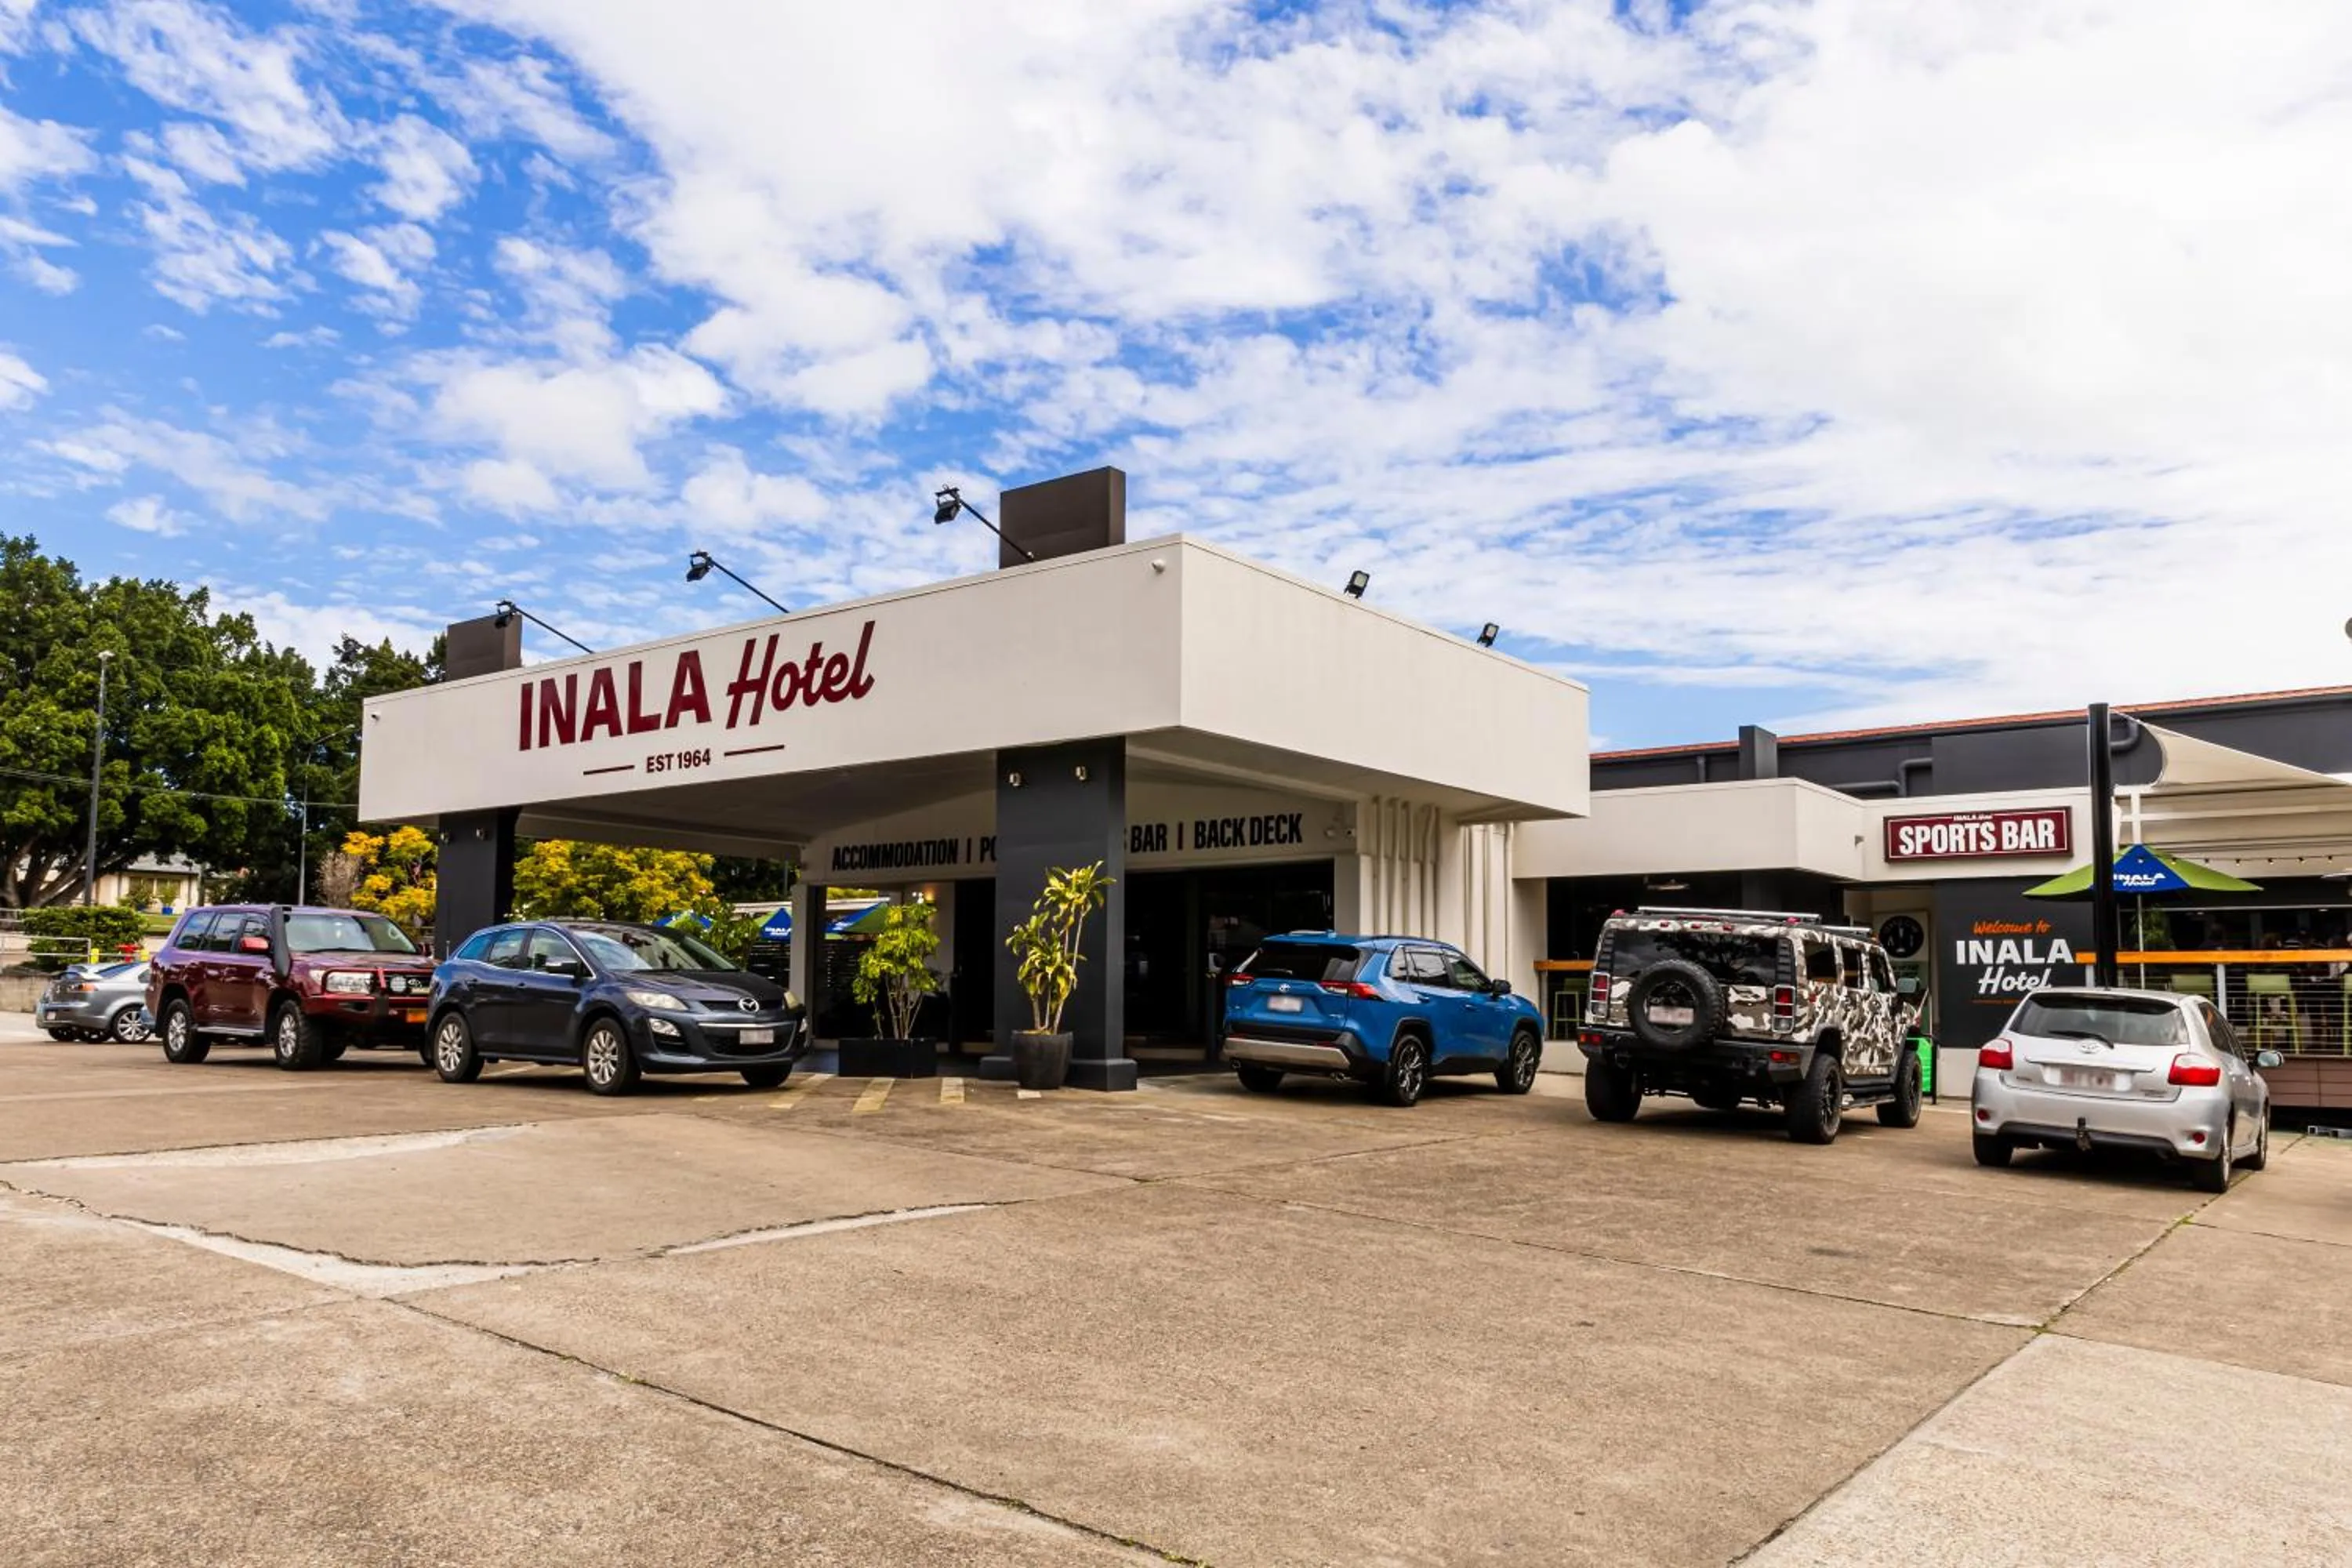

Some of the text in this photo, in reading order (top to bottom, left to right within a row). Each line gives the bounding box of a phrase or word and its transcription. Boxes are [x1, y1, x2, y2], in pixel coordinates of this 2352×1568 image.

[519, 621, 876, 751] INALA Hotel
[647, 749, 710, 773] EST 1964
[1131, 823, 1167, 853] BAR
[1194, 817, 1246, 849] BACK
[1249, 813, 1303, 844] DECK
[1898, 818, 2056, 855] SPORTS BAR
[832, 838, 958, 871] ACCOMMODATION
[1973, 918, 2051, 935] Welcome to
[1956, 938, 2074, 964] INALA
[1978, 966, 2053, 994] Hotel
